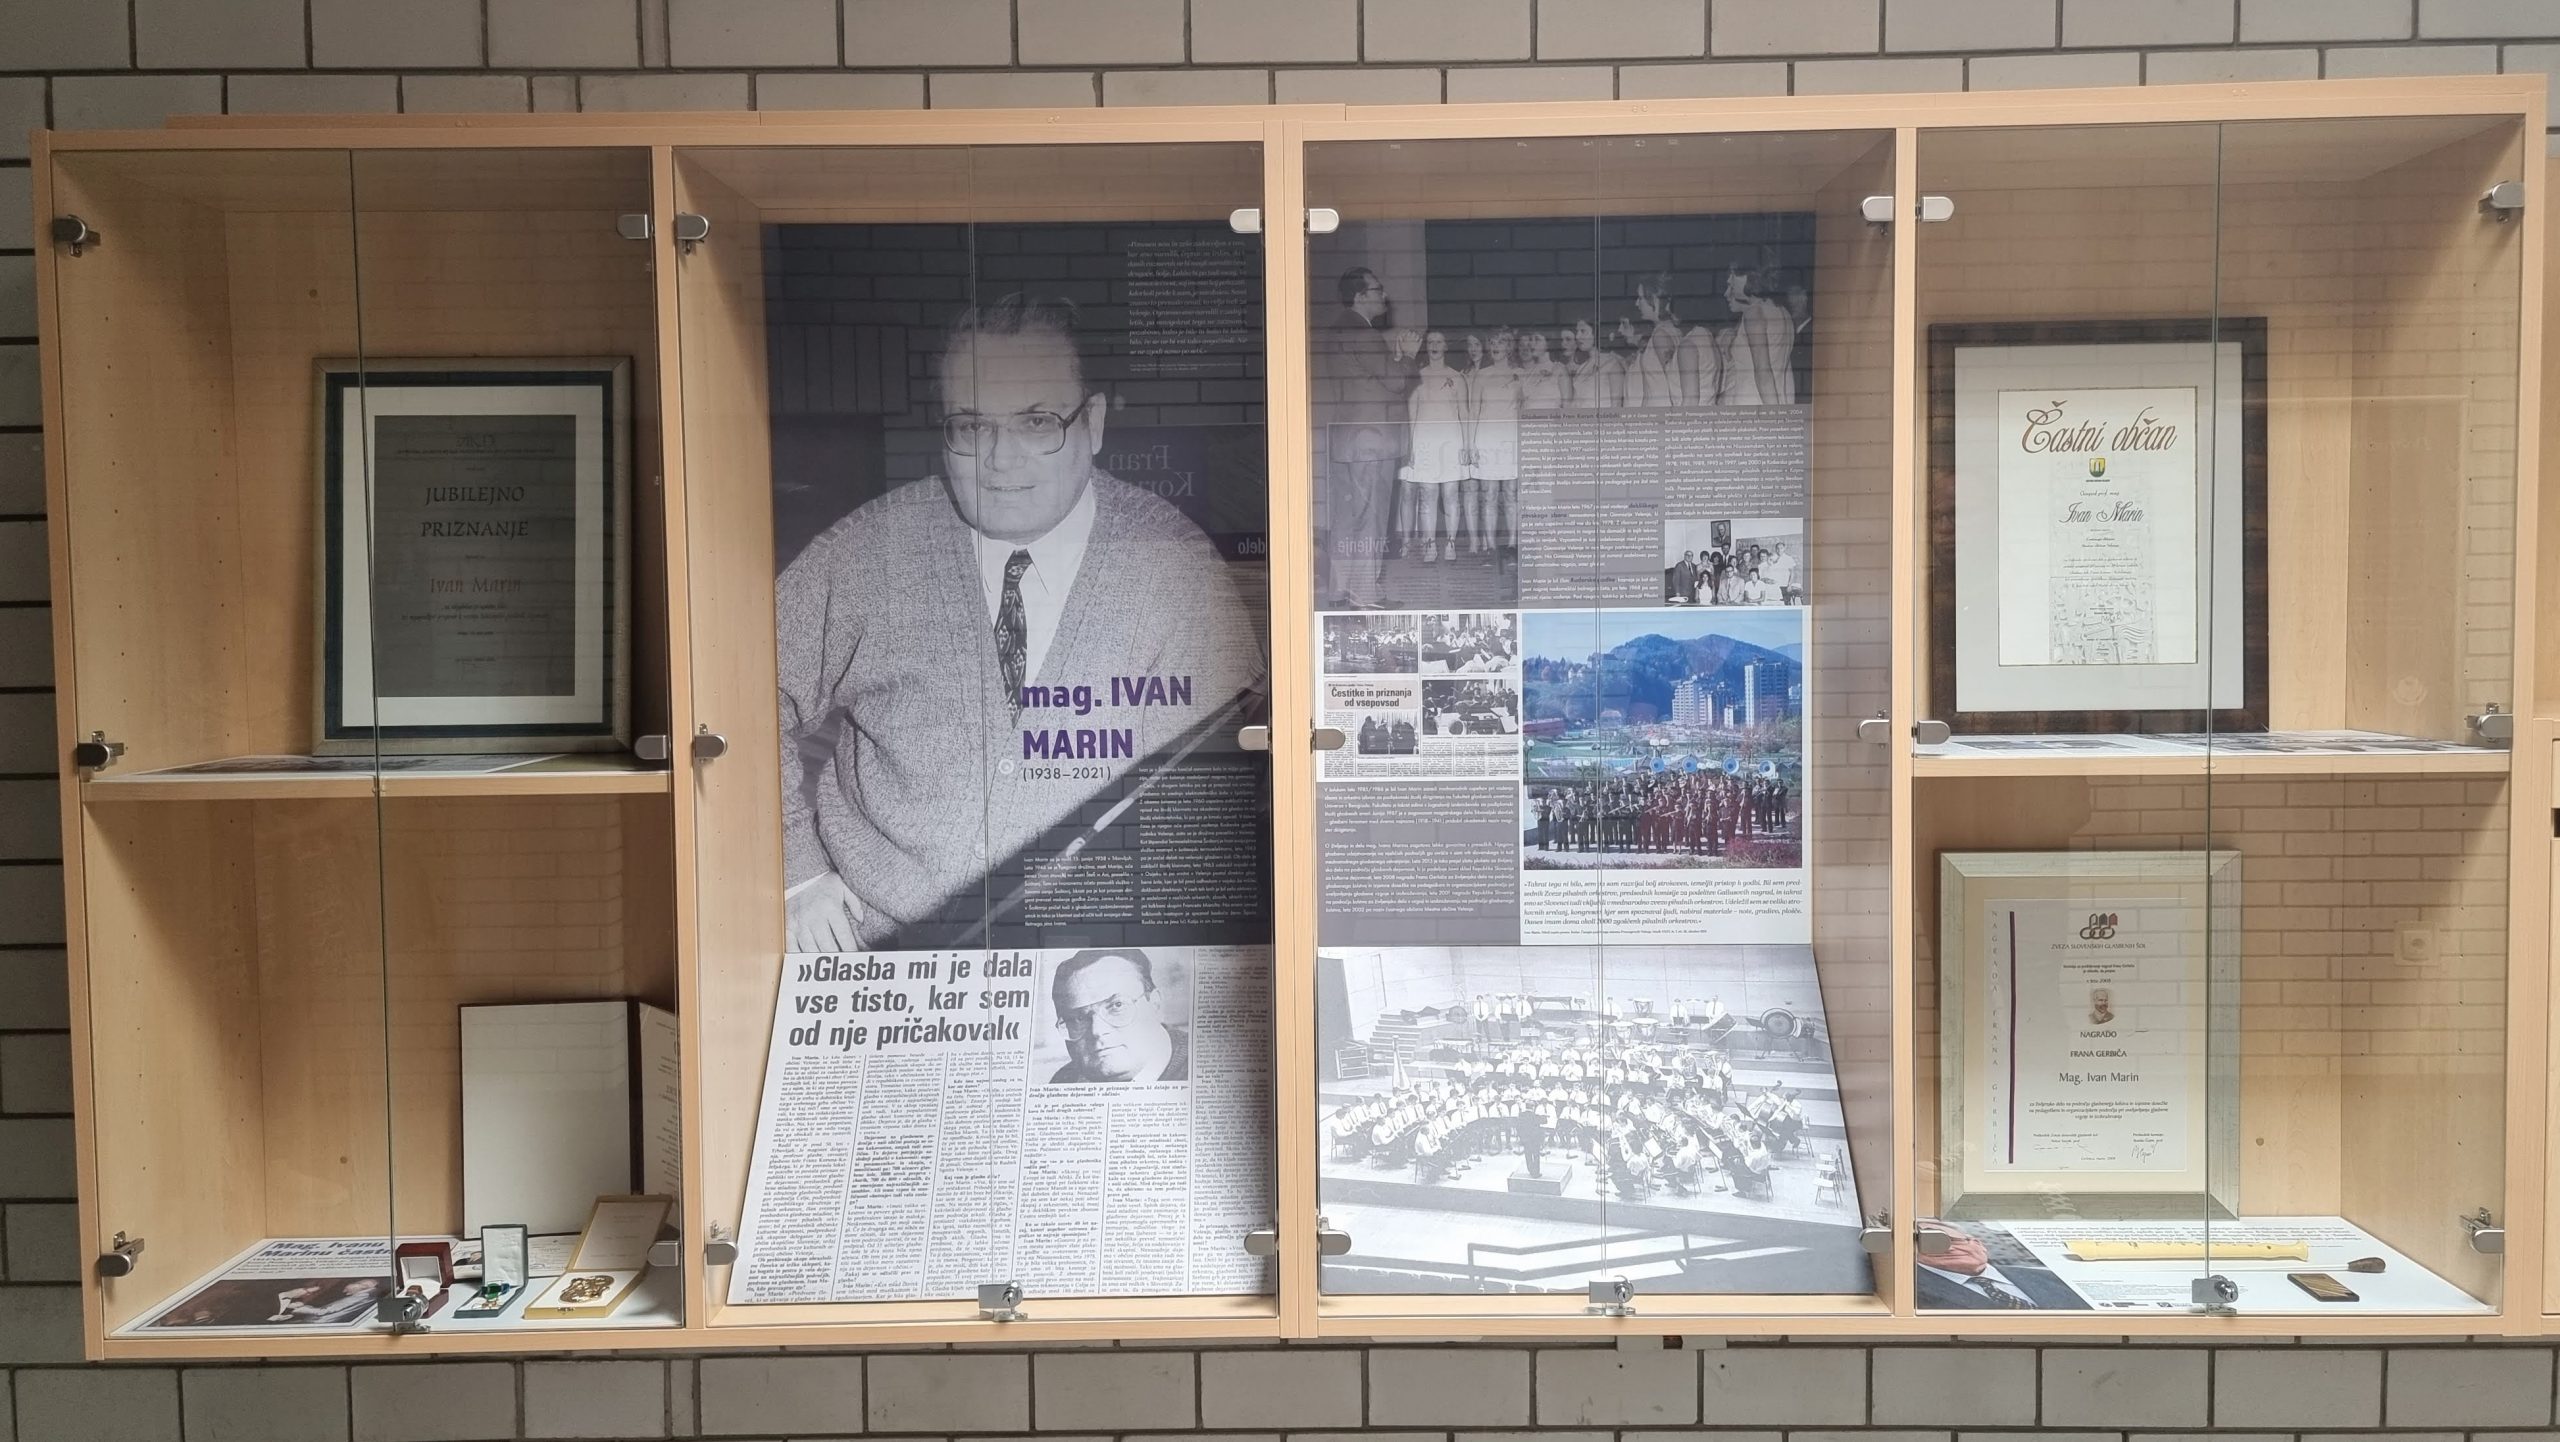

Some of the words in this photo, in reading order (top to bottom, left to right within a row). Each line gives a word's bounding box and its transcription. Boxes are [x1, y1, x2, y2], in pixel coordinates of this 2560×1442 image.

[2021, 400, 2108, 454] Častni
[2111, 406, 2178, 452] občan
[425, 486, 525, 505] JUBILEJNO
[2059, 501, 2093, 523] Ivan
[2096, 501, 2145, 522] Marin
[421, 521, 529, 540] PRIZNANJE
[430, 577, 464, 593] Ivan
[472, 576, 521, 593] Marin
[1021, 684, 1103, 715] mag.
[1111, 676, 1192, 707] IVAN
[1331, 687, 1364, 698] Čestitke
[1366, 688, 1374, 697] in
[1376, 688, 1412, 698] priznanja
[1344, 698, 1354, 707] od
[1356, 698, 1400, 708] vsepovsod
[1023, 729, 1133, 760] MARIN
[797, 955, 896, 982] »Glasba
[907, 953, 937, 979] mi
[948, 953, 971, 984] je
[983, 952, 1033, 978] dala
[795, 993, 838, 1013] vse
[852, 986, 915, 1013] tisto,
[929, 985, 968, 1010] kar
[979, 990, 1030, 1009] sem
[789, 1019, 821, 1046] od
[829, 1020, 868, 1052] nje
[876, 1015, 1020, 1050] pričakoval«
[2095, 1049, 2127, 1057] GERBIČA
[2059, 1072, 2083, 1085] Mag.
[2087, 1072, 2107, 1082] Ivan
[2110, 1072, 2139, 1082] Marin
[259, 1249, 332, 1257] Marinu
